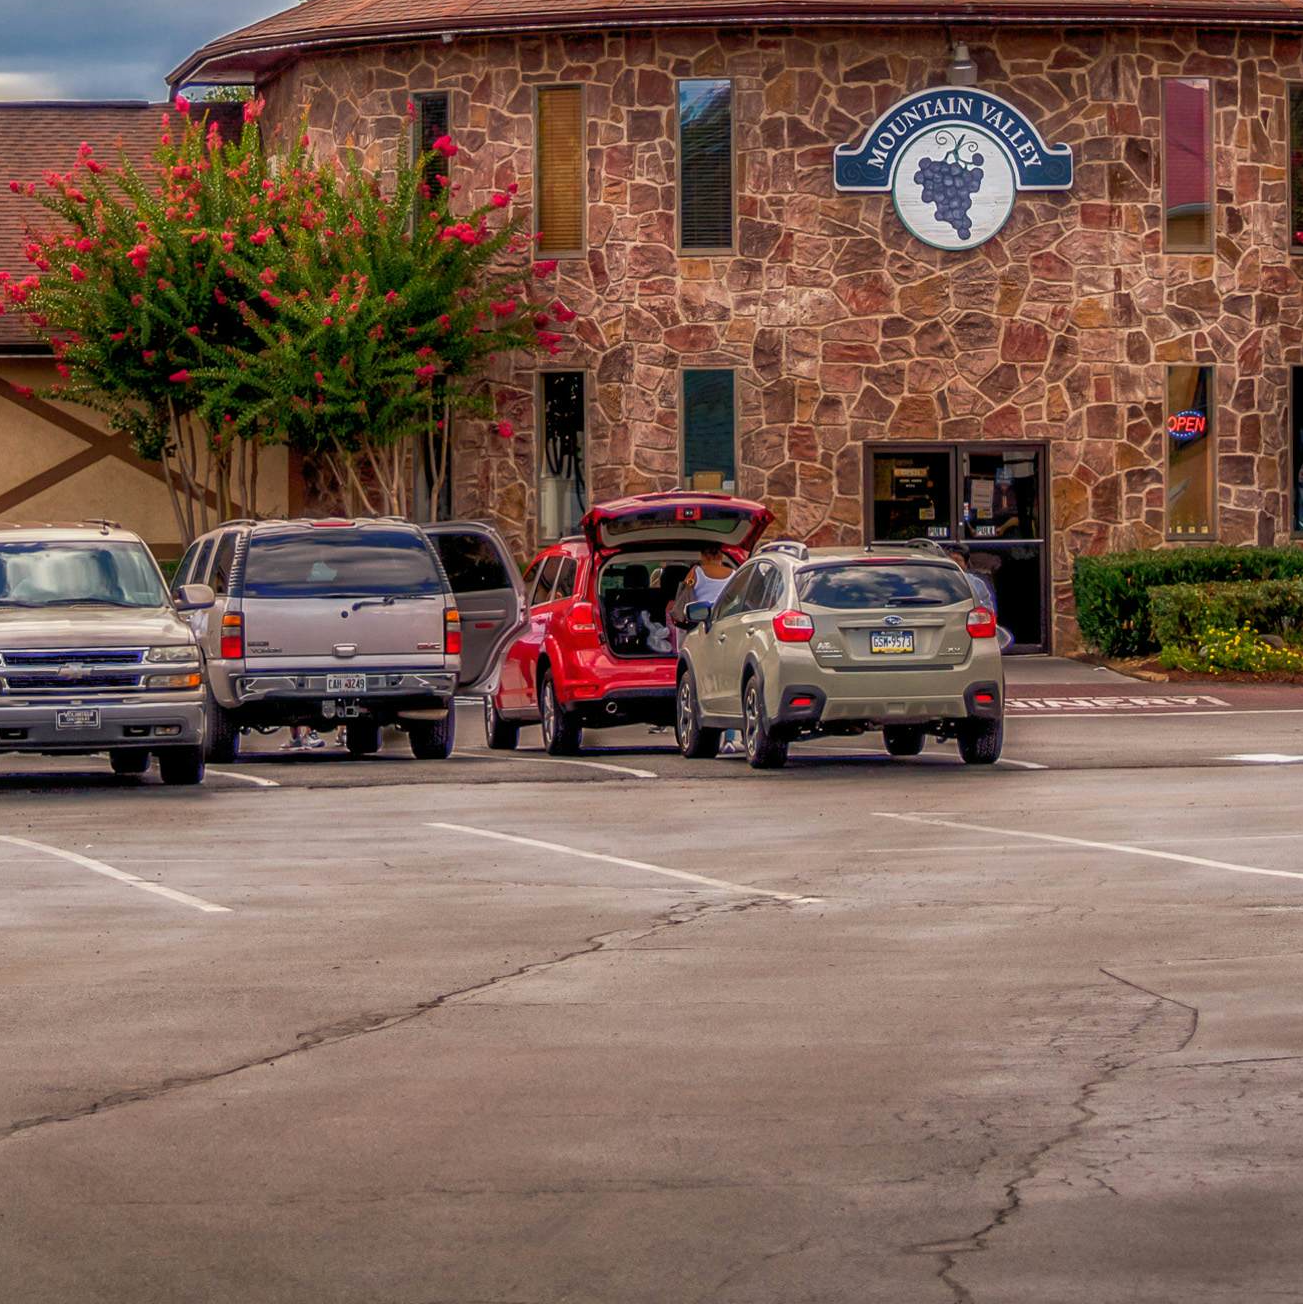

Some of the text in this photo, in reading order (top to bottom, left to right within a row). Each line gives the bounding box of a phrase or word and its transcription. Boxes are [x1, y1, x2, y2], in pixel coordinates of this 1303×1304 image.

[867, 97, 1042, 170] MOUNTAIN VALLEY
[1167, 416, 1205, 432] OPEN
